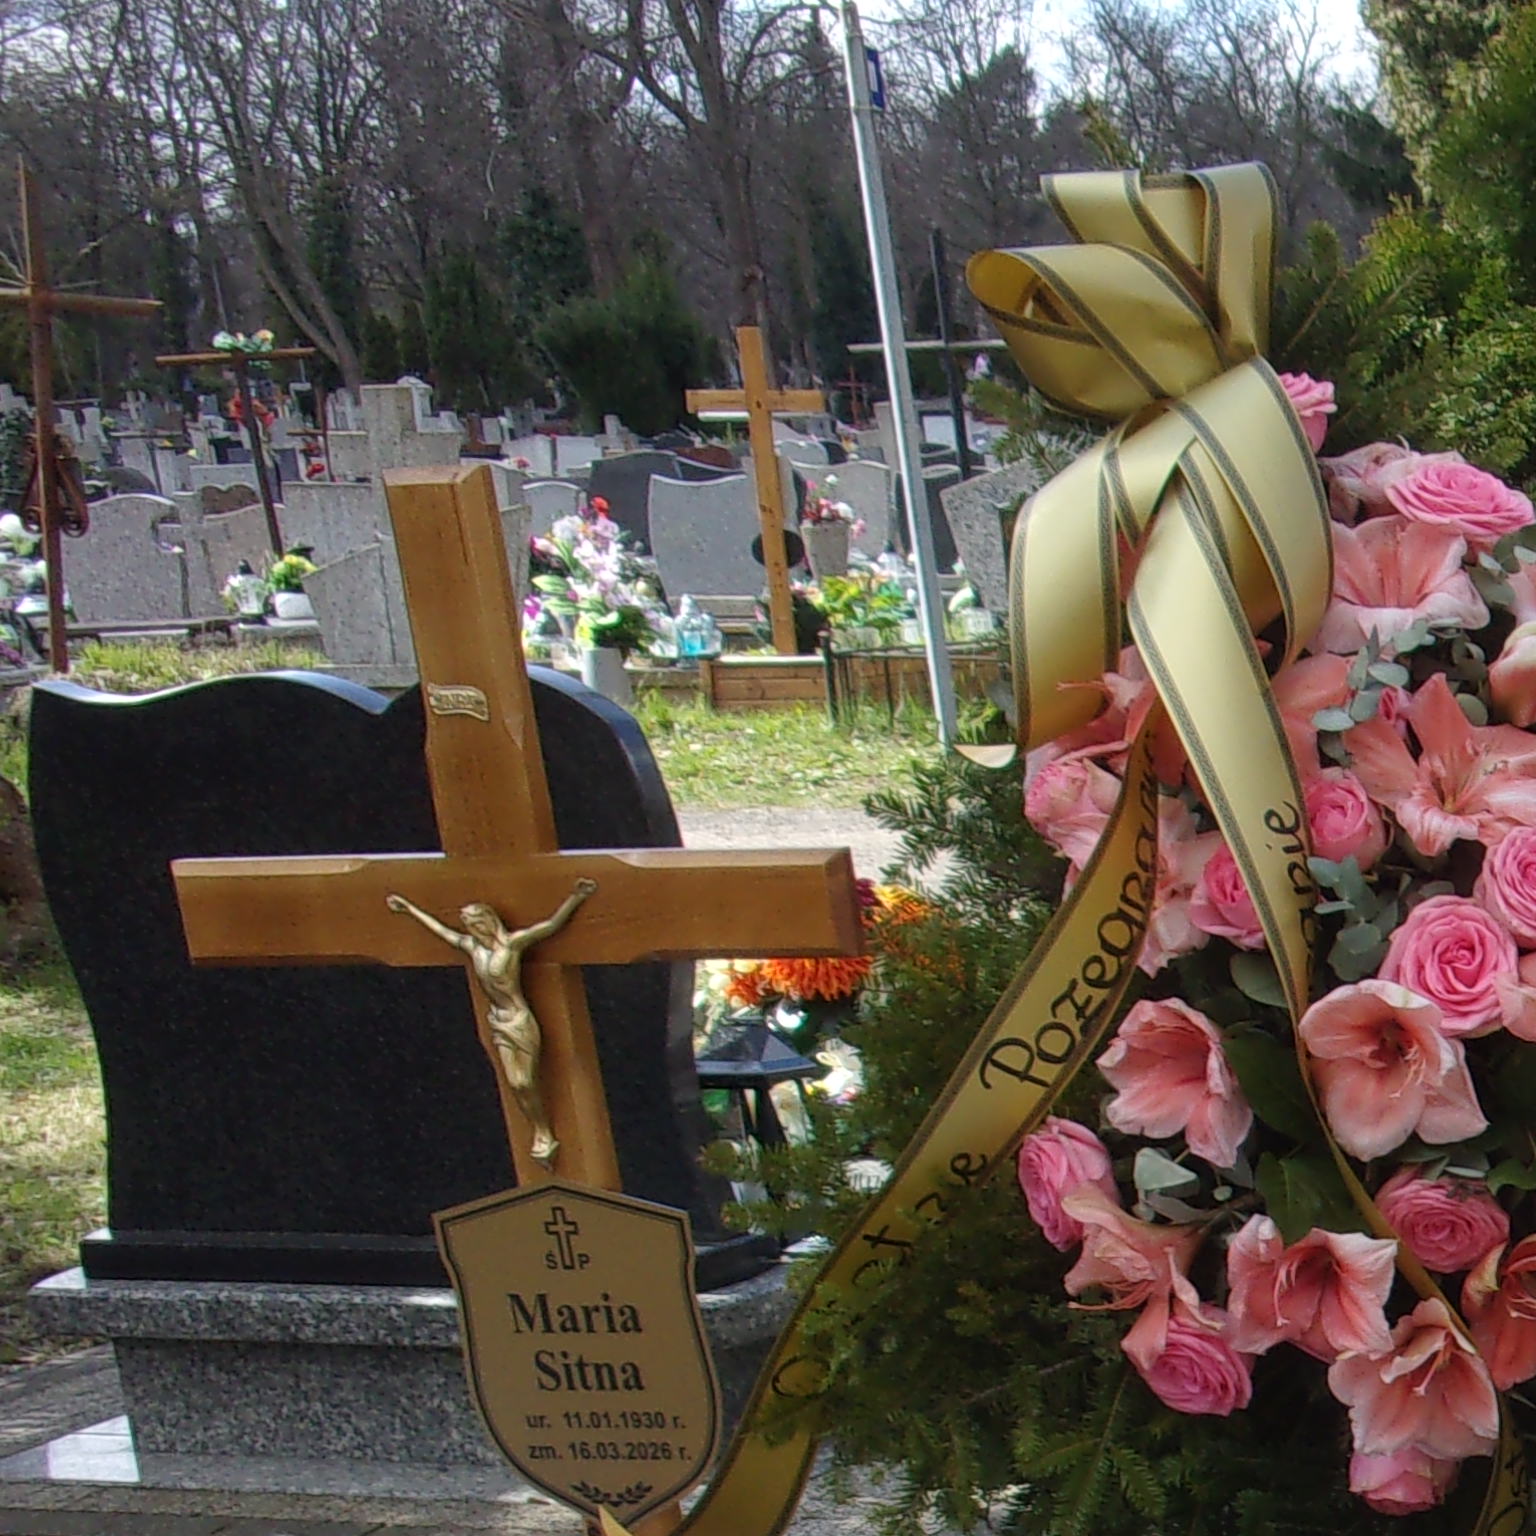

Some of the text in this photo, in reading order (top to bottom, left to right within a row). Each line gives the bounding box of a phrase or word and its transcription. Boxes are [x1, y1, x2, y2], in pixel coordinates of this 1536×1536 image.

[507, 1292, 643, 1334] Maria
[535, 1349, 645, 1392] Sitna
[526, 1411, 687, 1430] ur. 11.01.1930 r.
[528, 1442, 692, 1461] zm. 16.03.2026 r.
